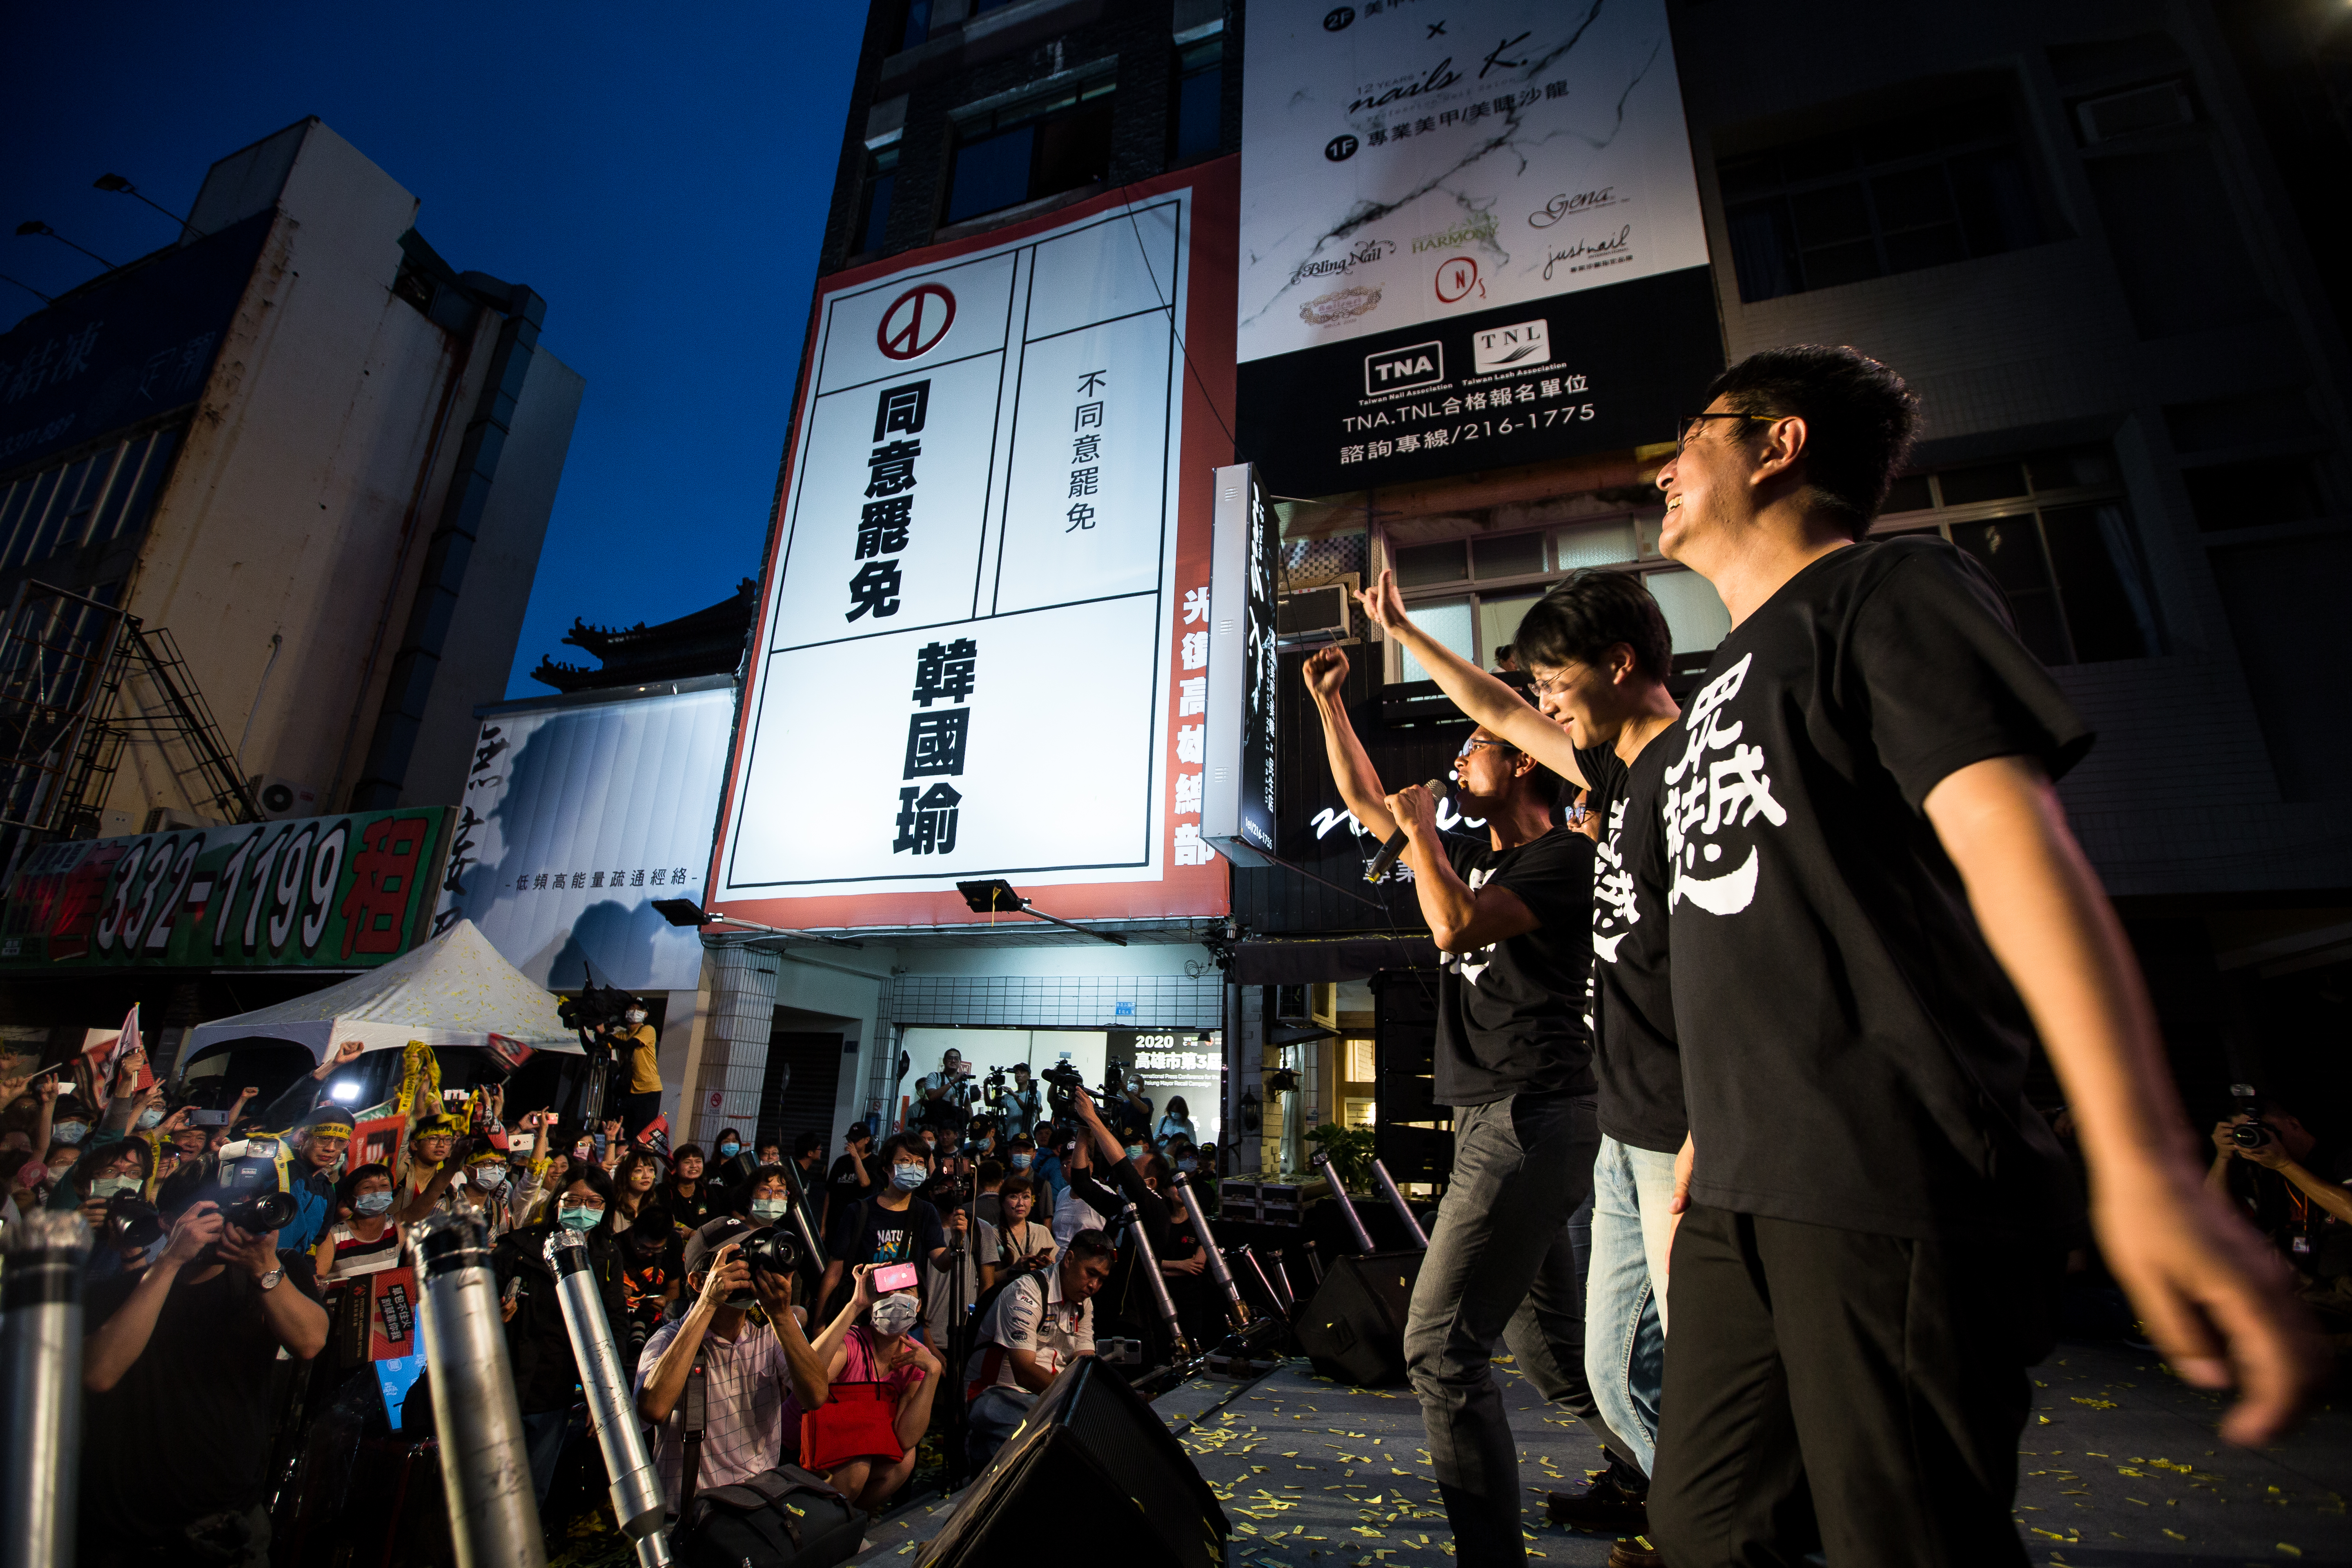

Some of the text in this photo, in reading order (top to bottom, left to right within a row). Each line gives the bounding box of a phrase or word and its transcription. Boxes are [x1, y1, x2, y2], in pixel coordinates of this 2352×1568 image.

[1349, 56, 1463, 114] nails
[1329, 137, 1355, 158] 1F
[1528, 186, 1615, 229] Gena
[1412, 223, 1499, 254] HARMONY
[1294, 244, 1383, 281] Bling Nail
[1481, 325, 1543, 350] TNL
[1374, 355, 1434, 381] TNA
[1461, 361, 1568, 386] Taiwan Lash Association
[1342, 374, 1589, 433] TNA.TNL合格報名單位
[1359, 383, 1453, 406] Taiwan Nail Association
[1065, 369, 1107, 533] 不同意罷免
[1340, 403, 1595, 465] 諮詢專線/216-1775
[844, 378, 931, 624] 同意罷免
[1250, 481, 1264, 602] nails
[892, 637, 978, 856] 韓國瑜
[97, 815, 352, 960] 332-1199
[340, 816, 428, 961] 租
[1135, 1035, 1174, 1049] 2020
[1134, 1051, 1222, 1071] 高雄市第3屆
[1020, 1296, 1033, 1305] FILA
